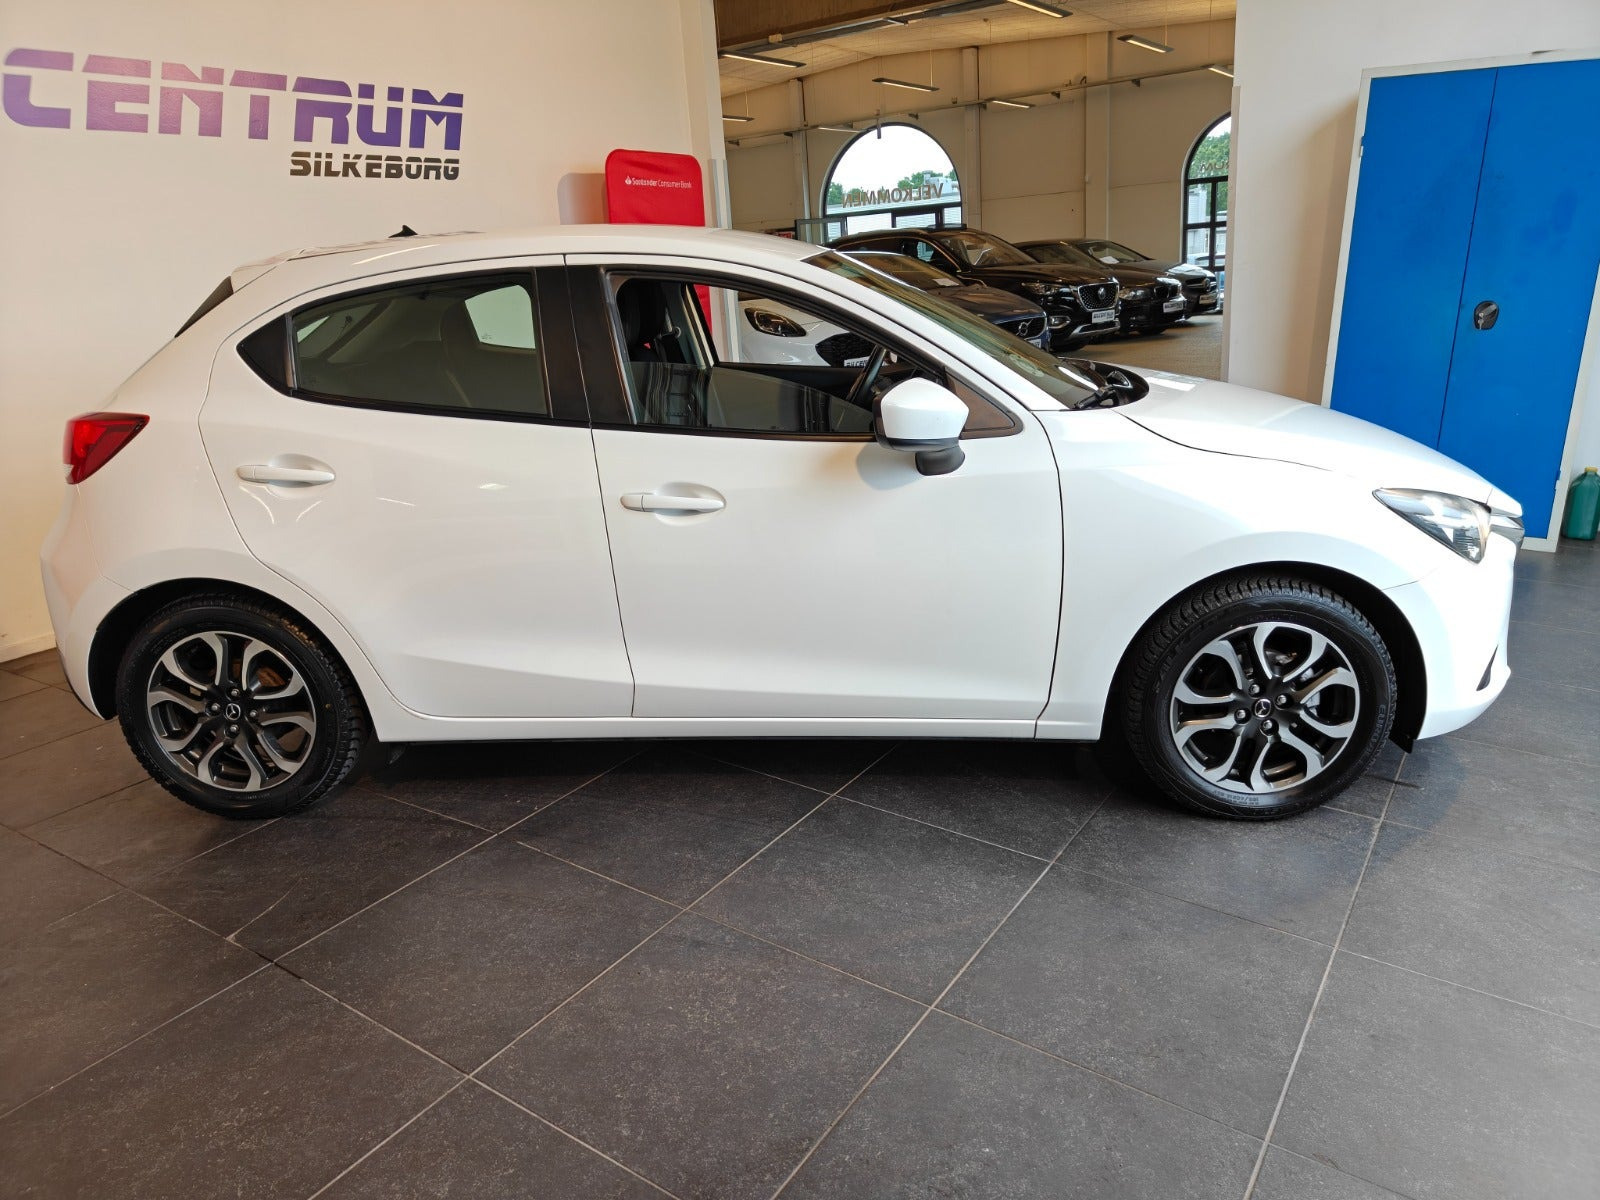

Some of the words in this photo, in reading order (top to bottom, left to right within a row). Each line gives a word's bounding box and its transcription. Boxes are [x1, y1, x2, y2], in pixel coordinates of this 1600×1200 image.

[2, 48, 464, 151] CENTRUM
[289, 151, 460, 181] SILKEBORG
[631, 177, 657, 187] Santander
